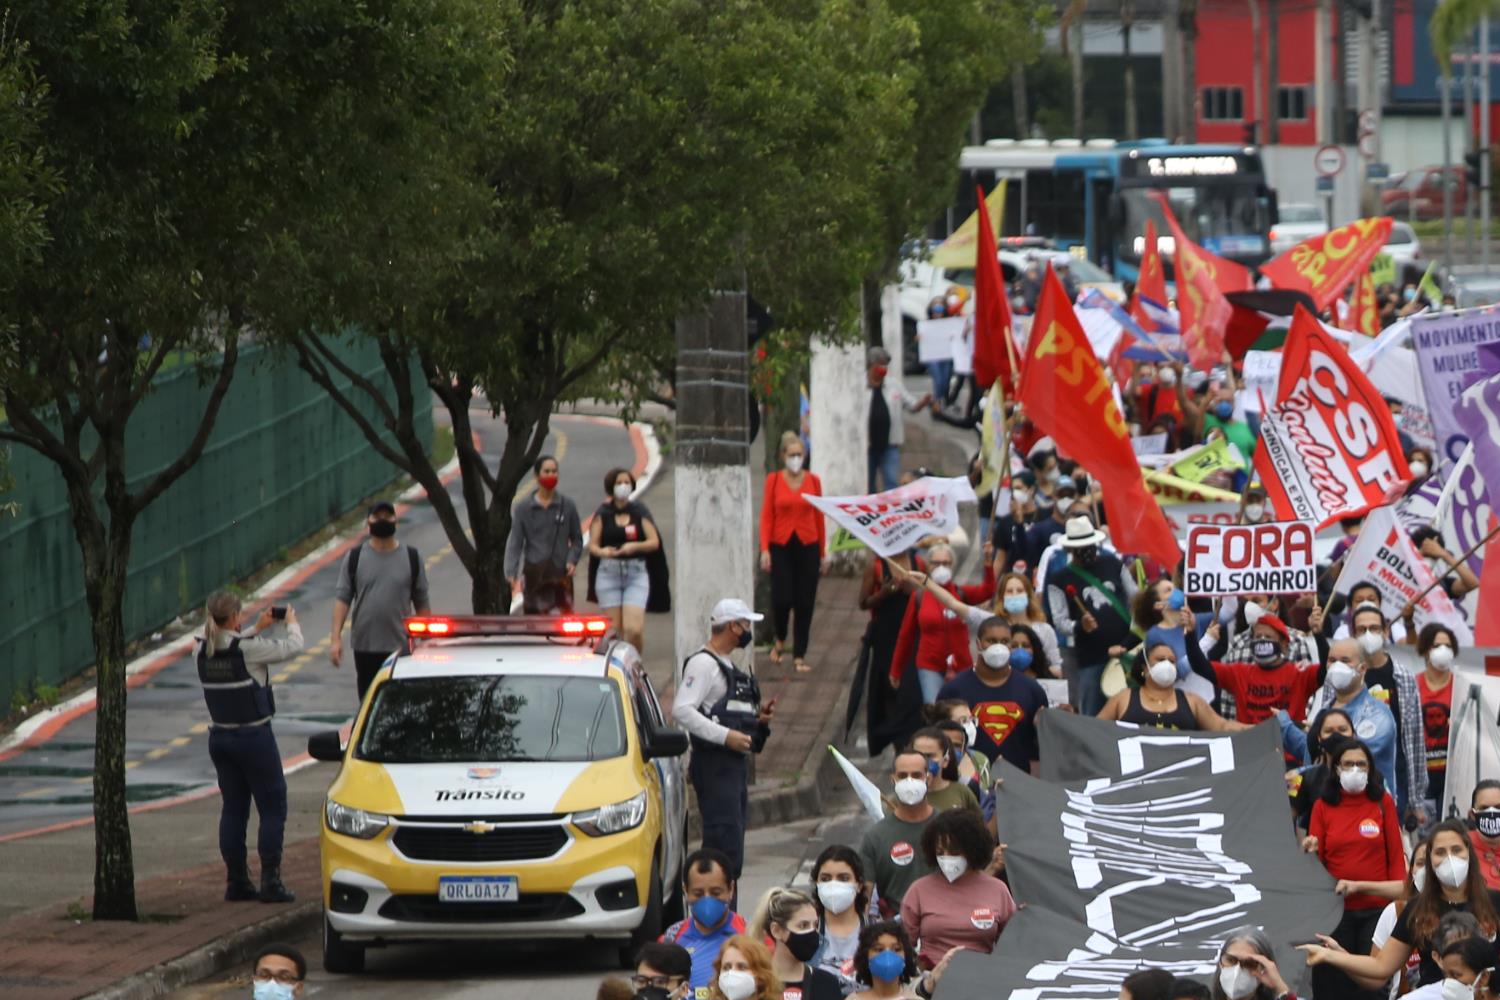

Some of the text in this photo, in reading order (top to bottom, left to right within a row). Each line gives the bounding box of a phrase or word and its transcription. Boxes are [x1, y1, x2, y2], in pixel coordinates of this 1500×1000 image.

[1433, 351, 1478, 374] MULHE
[1308, 350, 1400, 496] CSP
[1262, 425, 1312, 520] SINDICAL E POP
[1187, 524, 1313, 570] FORA
[1376, 546, 1420, 586] BOLS
[1186, 569, 1314, 593] BOLSONARO!
[435, 788, 526, 802] Trânsito
